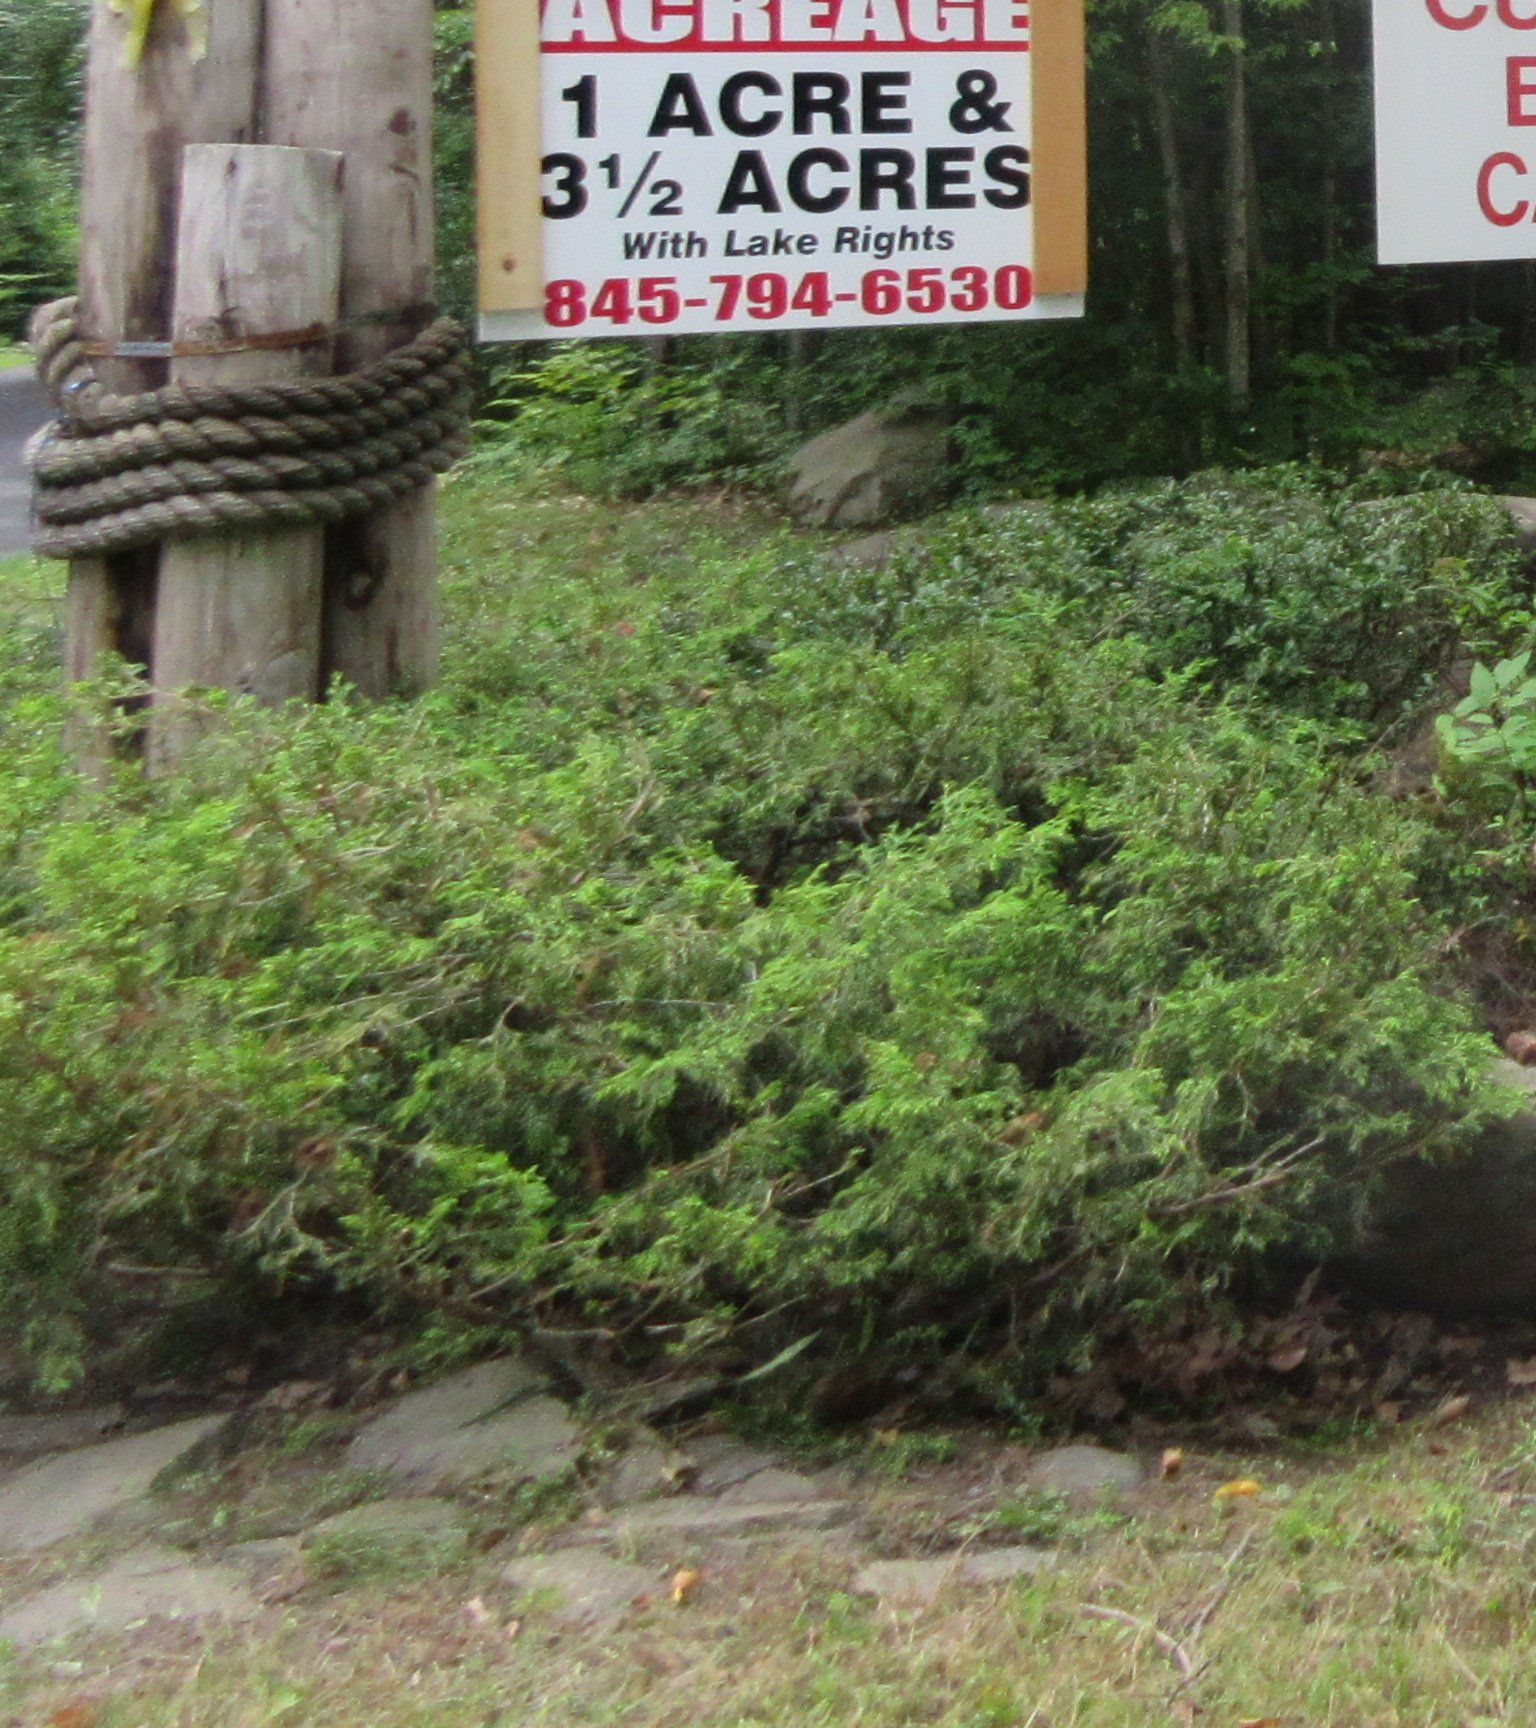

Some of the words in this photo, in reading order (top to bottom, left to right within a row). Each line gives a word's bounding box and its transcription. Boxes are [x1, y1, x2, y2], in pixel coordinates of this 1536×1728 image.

[562, 75, 597, 137] 1
[648, 71, 912, 137] ACRE
[948, 69, 1014, 134] &
[717, 146, 1031, 214] ACRES
[622, 230, 707, 261] With
[725, 227, 818, 257] Lake
[834, 225, 955, 259] Rights
[543, 265, 1033, 328] 845-794-6530
